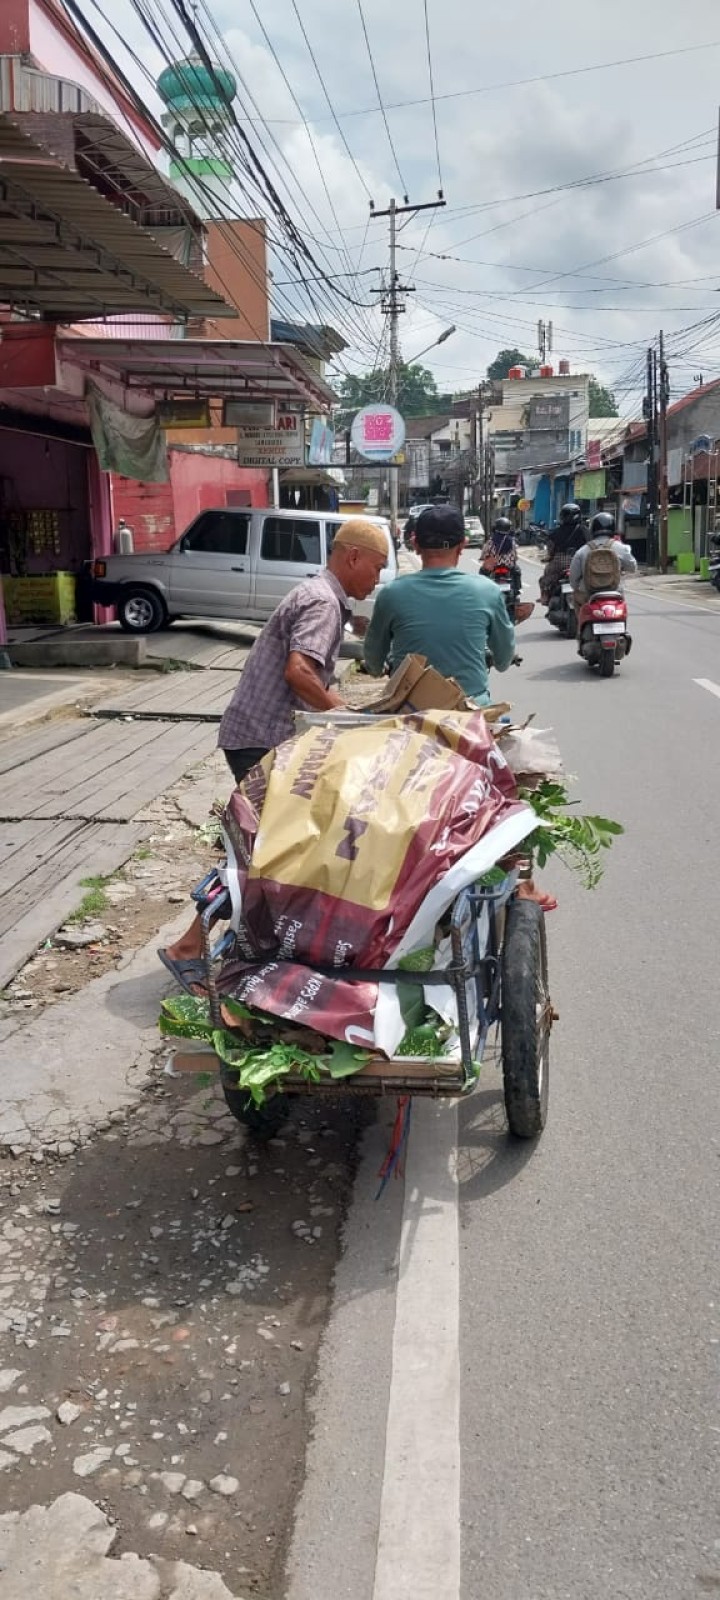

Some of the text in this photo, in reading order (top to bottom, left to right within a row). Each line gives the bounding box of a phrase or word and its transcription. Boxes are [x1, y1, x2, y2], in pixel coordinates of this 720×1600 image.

[243, 457, 302, 465] DIGITAL COPY
[299, 976, 323, 1001] KPPS
